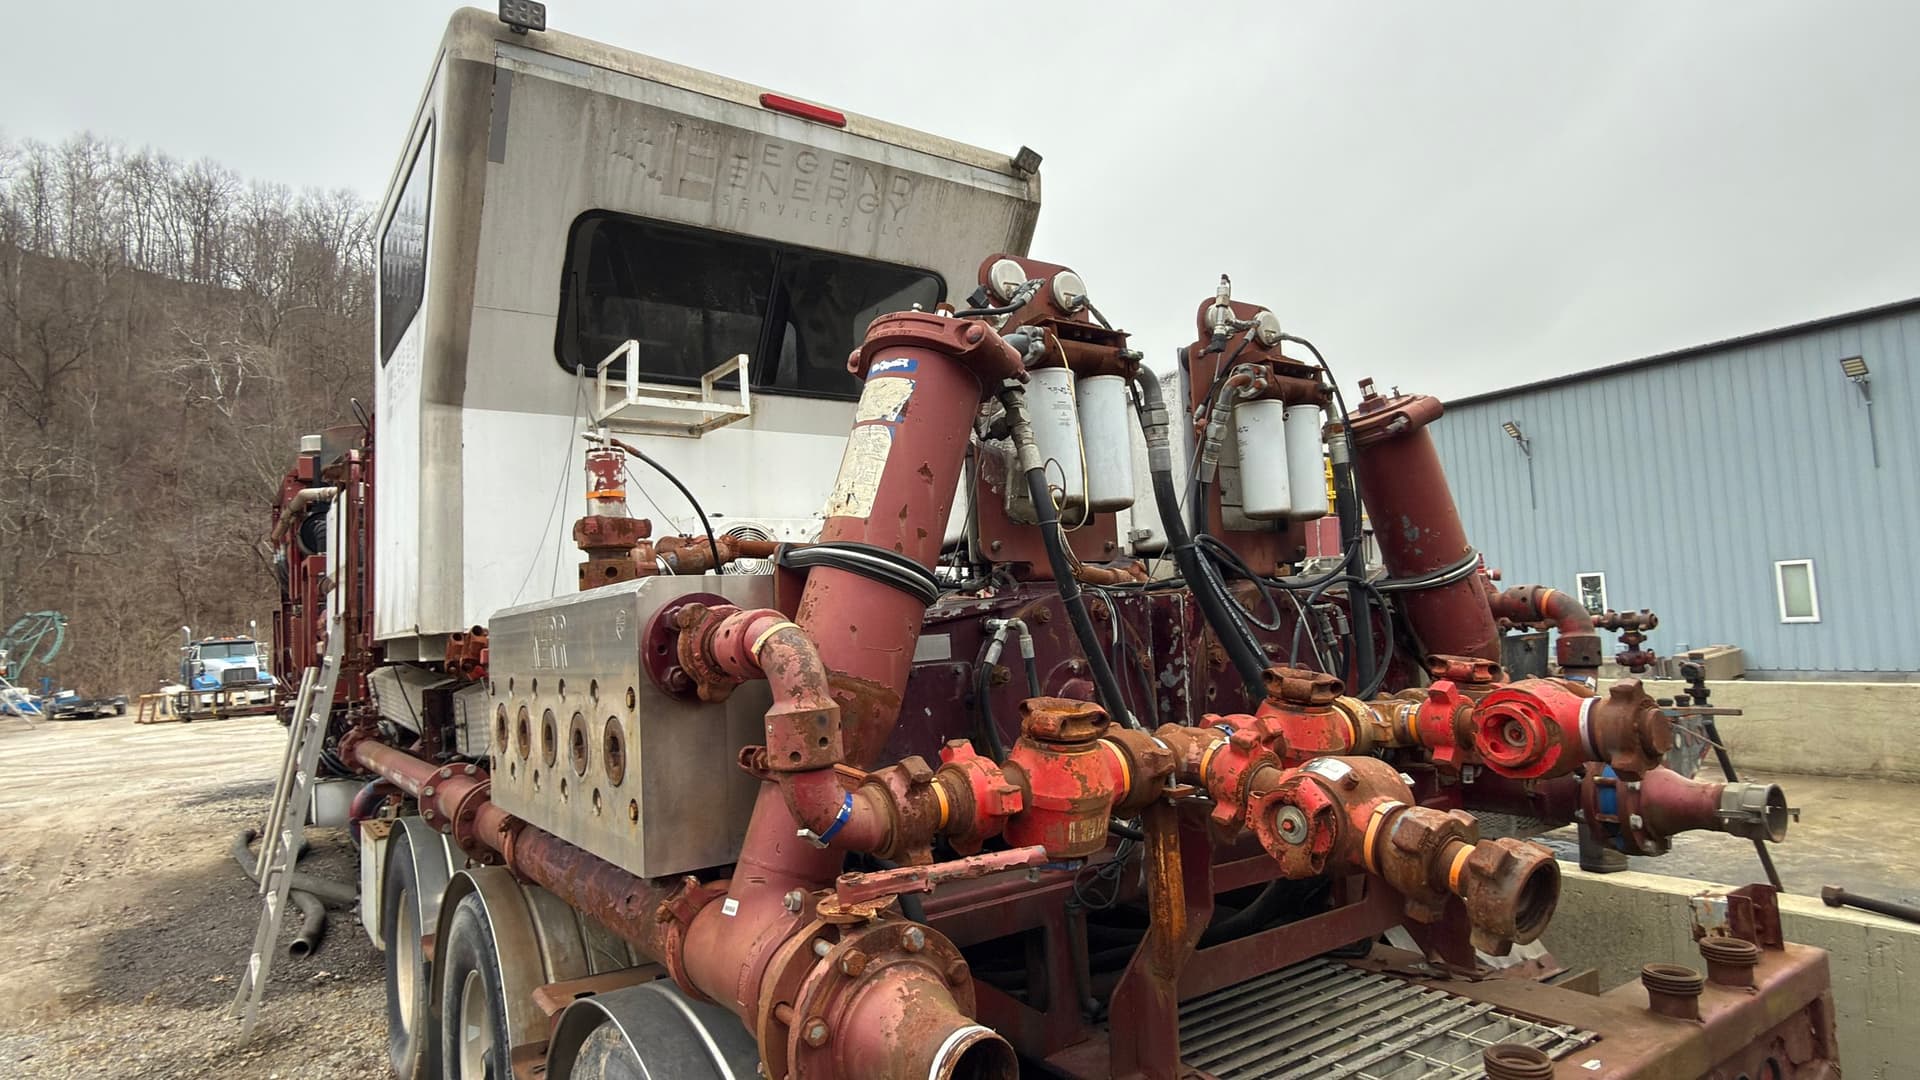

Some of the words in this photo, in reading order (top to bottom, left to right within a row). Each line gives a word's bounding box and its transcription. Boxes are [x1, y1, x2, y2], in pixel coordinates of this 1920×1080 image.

[718, 193, 850, 230] SERVICES
[865, 221, 906, 239] LLC
[728, 165, 910, 222] ENERGY
